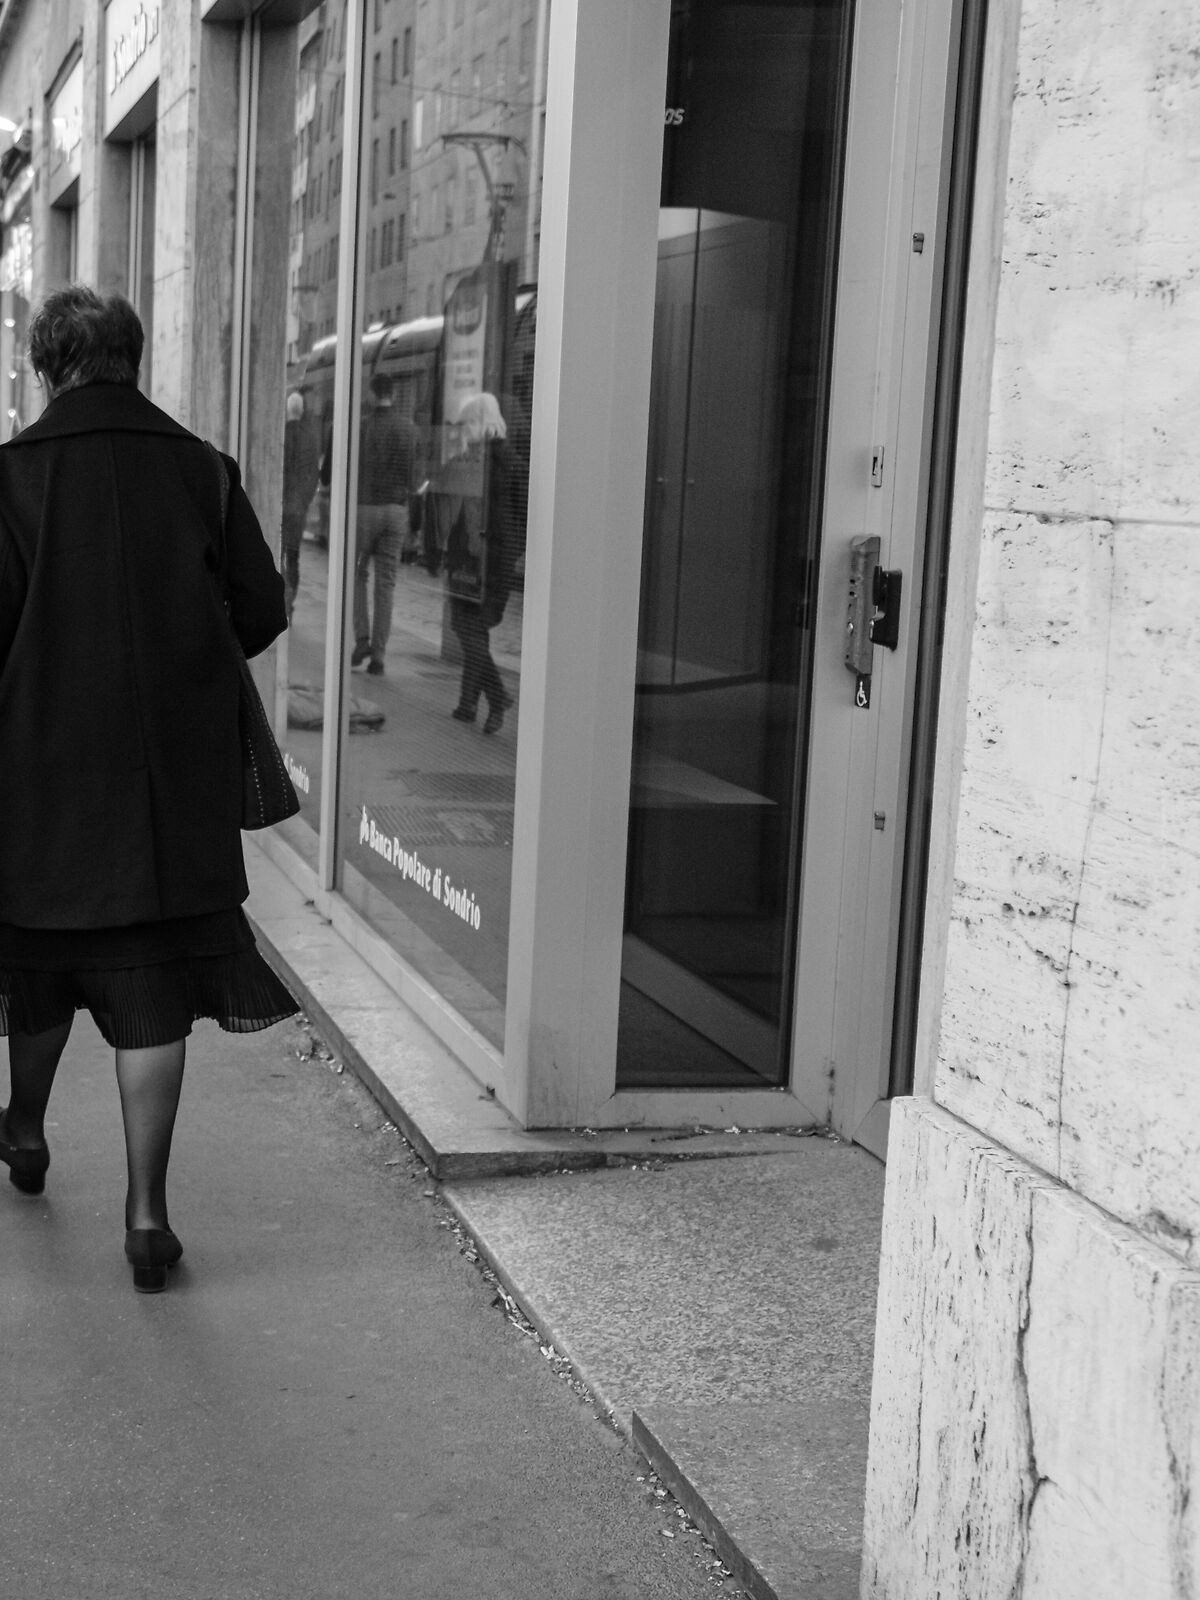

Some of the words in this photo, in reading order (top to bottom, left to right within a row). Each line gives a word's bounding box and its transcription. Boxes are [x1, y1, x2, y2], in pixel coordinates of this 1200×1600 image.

[369, 820, 392, 862] Banca
[393, 836, 431, 892] Popolare
[432, 868, 442, 900] di
[443, 875, 481, 931] Sondrio
